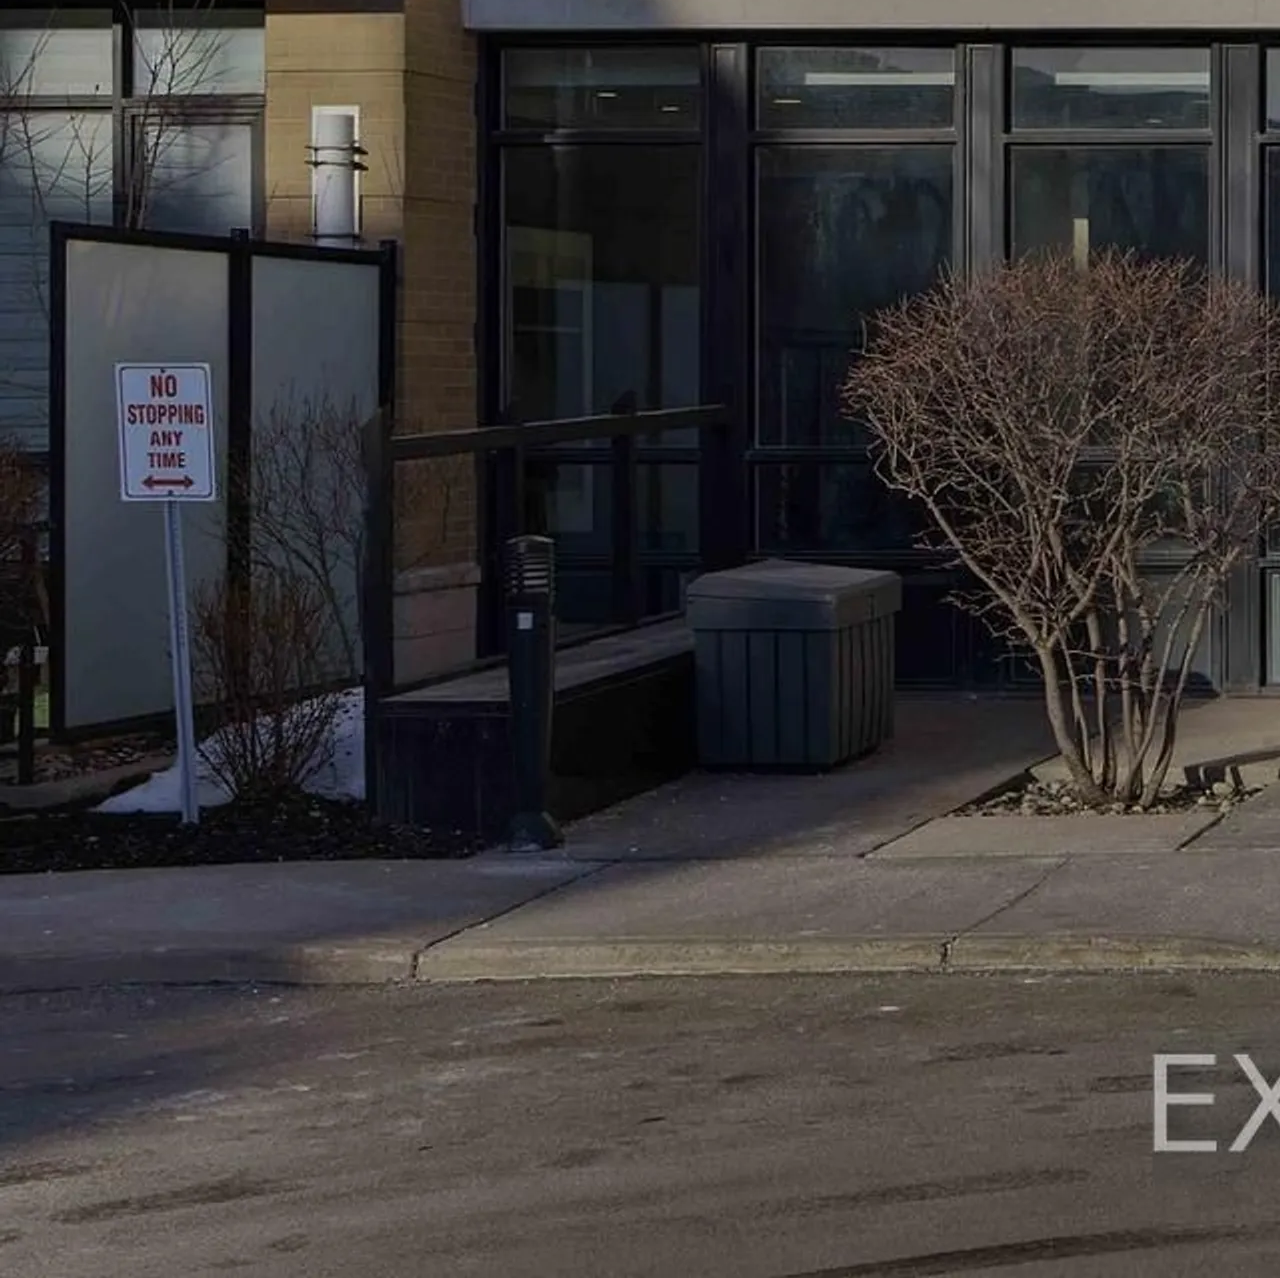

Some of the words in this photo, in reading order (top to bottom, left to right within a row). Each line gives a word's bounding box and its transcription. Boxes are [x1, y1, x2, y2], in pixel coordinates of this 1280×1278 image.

[150, 374, 177, 398] NO
[127, 404, 205, 425] STOPPING
[150, 430, 183, 447] ANY
[147, 452, 186, 468] TIME
